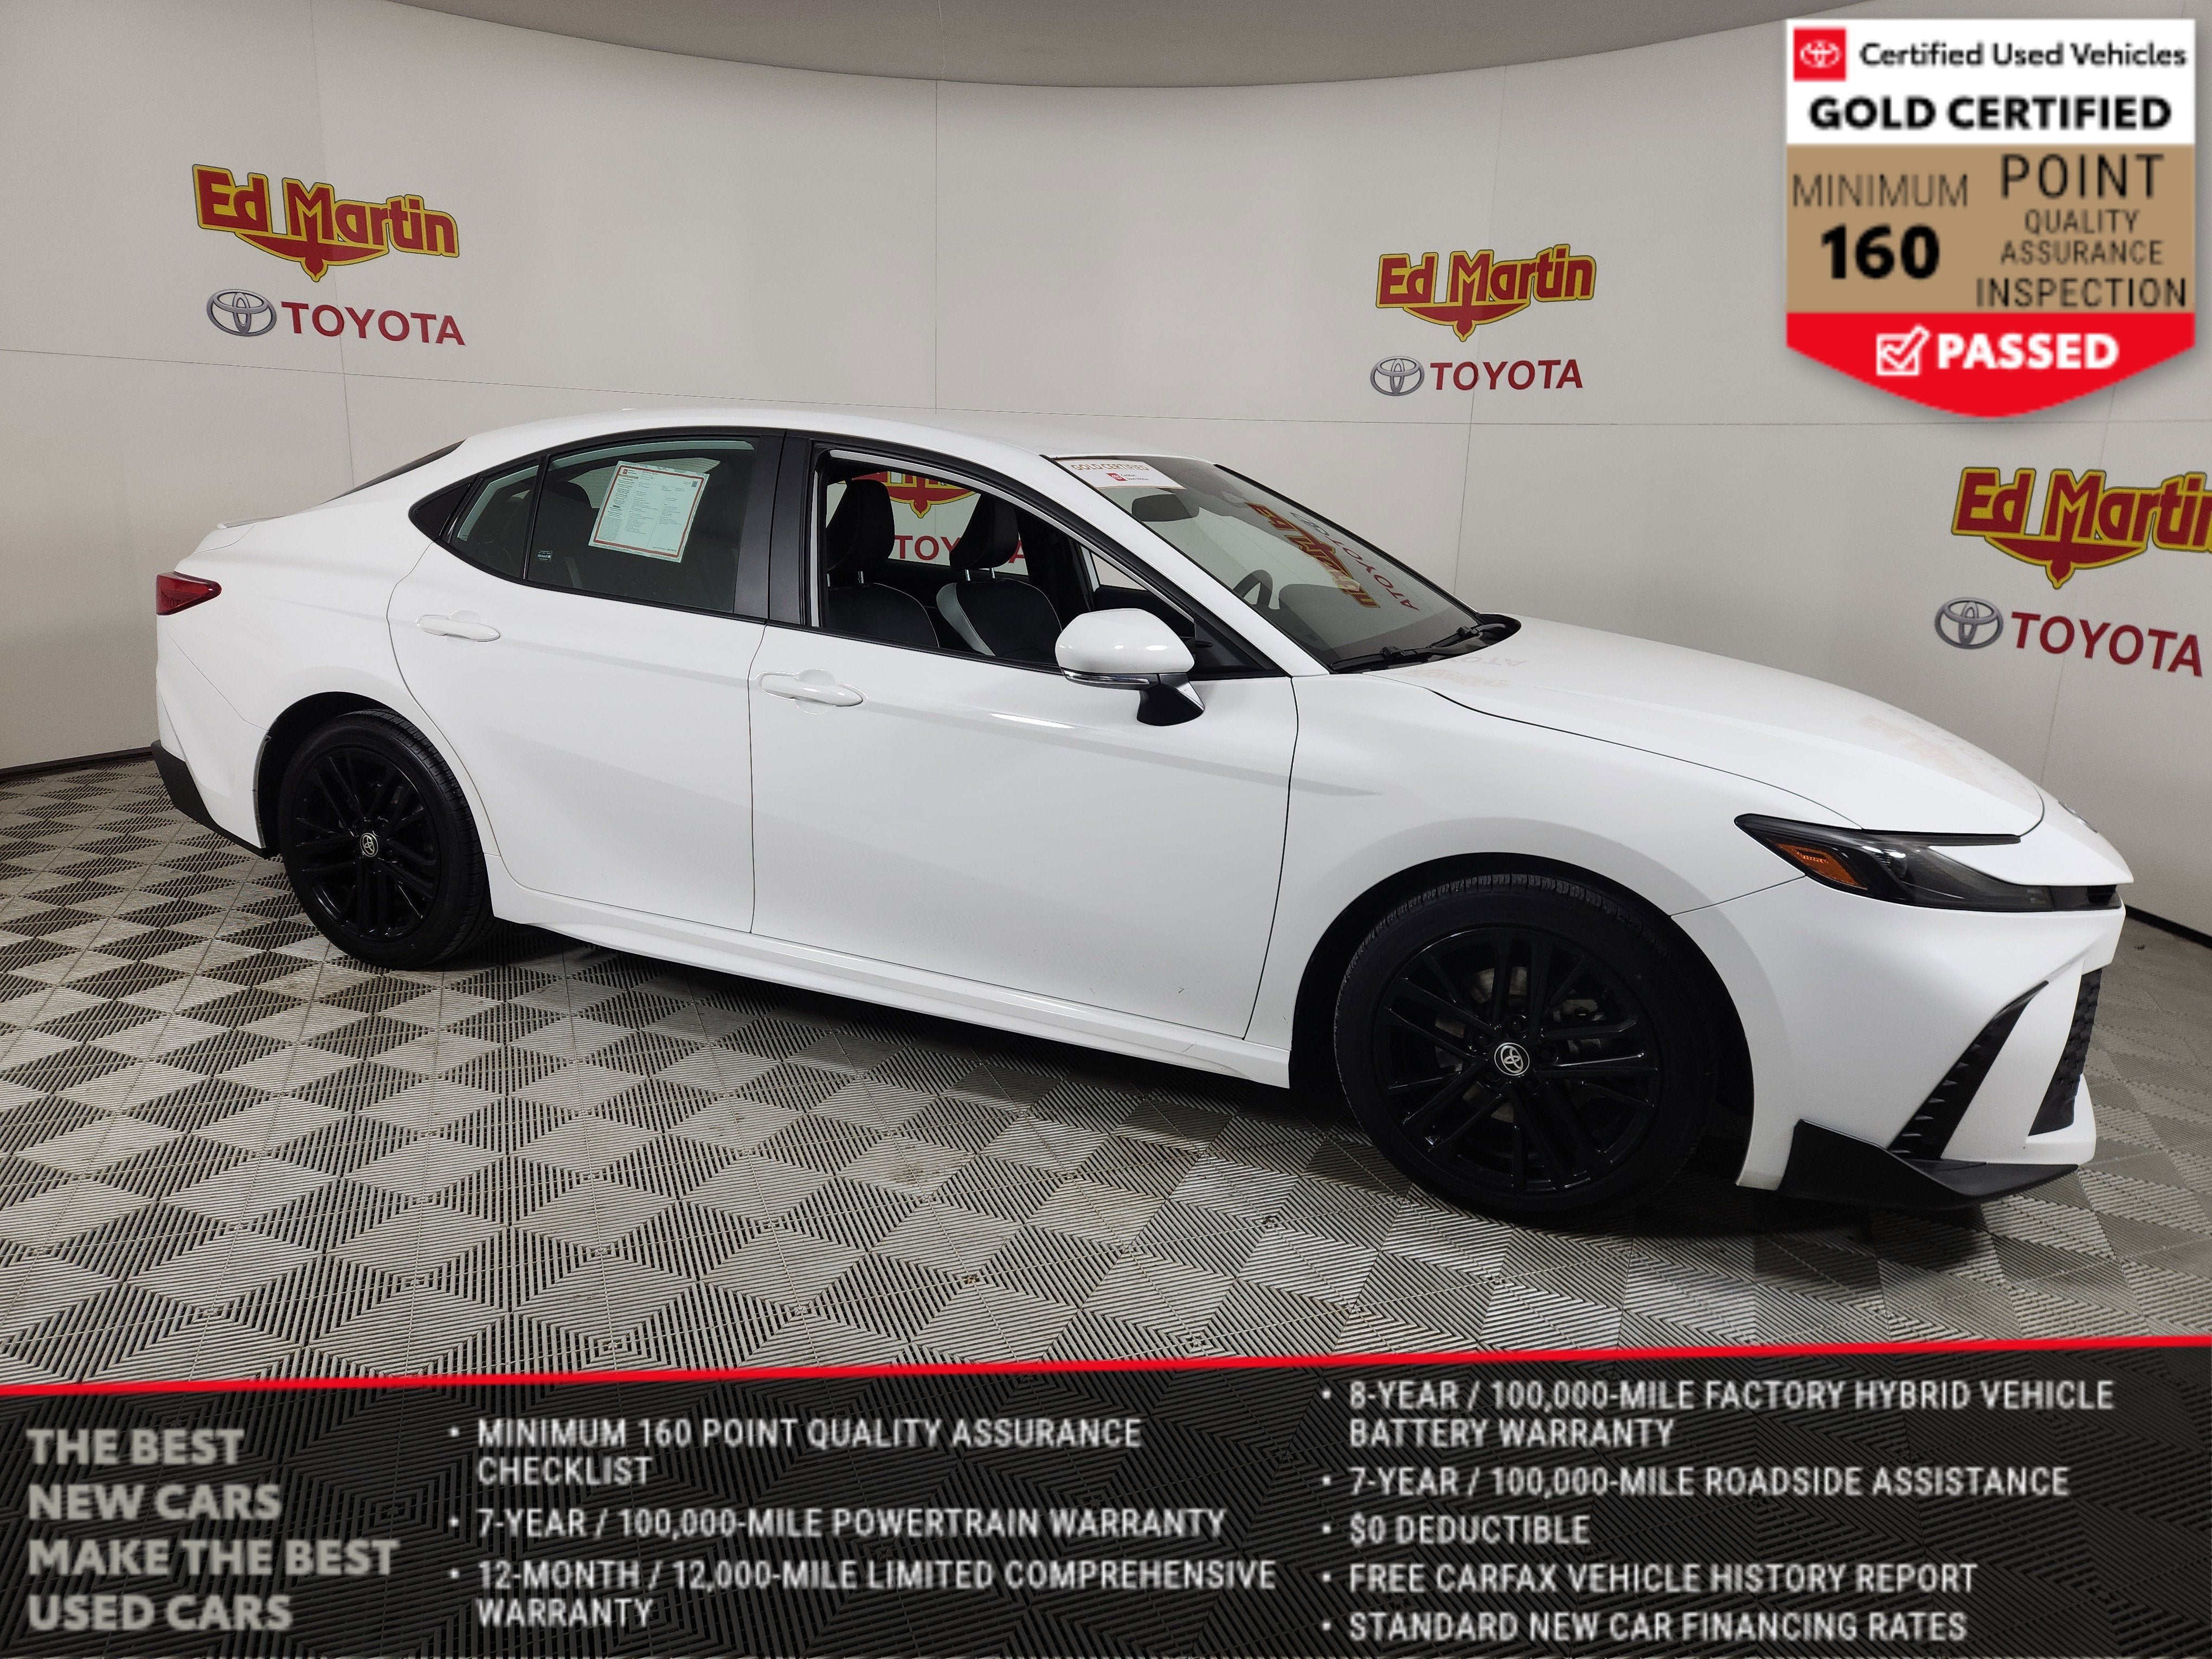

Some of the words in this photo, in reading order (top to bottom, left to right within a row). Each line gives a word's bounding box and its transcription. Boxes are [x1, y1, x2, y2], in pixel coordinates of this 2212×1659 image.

[192, 164, 271, 233] Ed
[282, 177, 459, 257] Martin
[1375, 252, 1438, 308] Ed
[1446, 243, 1596, 304] Martin
[281, 301, 466, 346] TOYOTA
[1430, 359, 1583, 390] TOYOTA
[1951, 467, 2036, 536] Ed
[895, 535, 1025, 564] TOYA
[2011, 611, 2203, 678] TOYOTA
